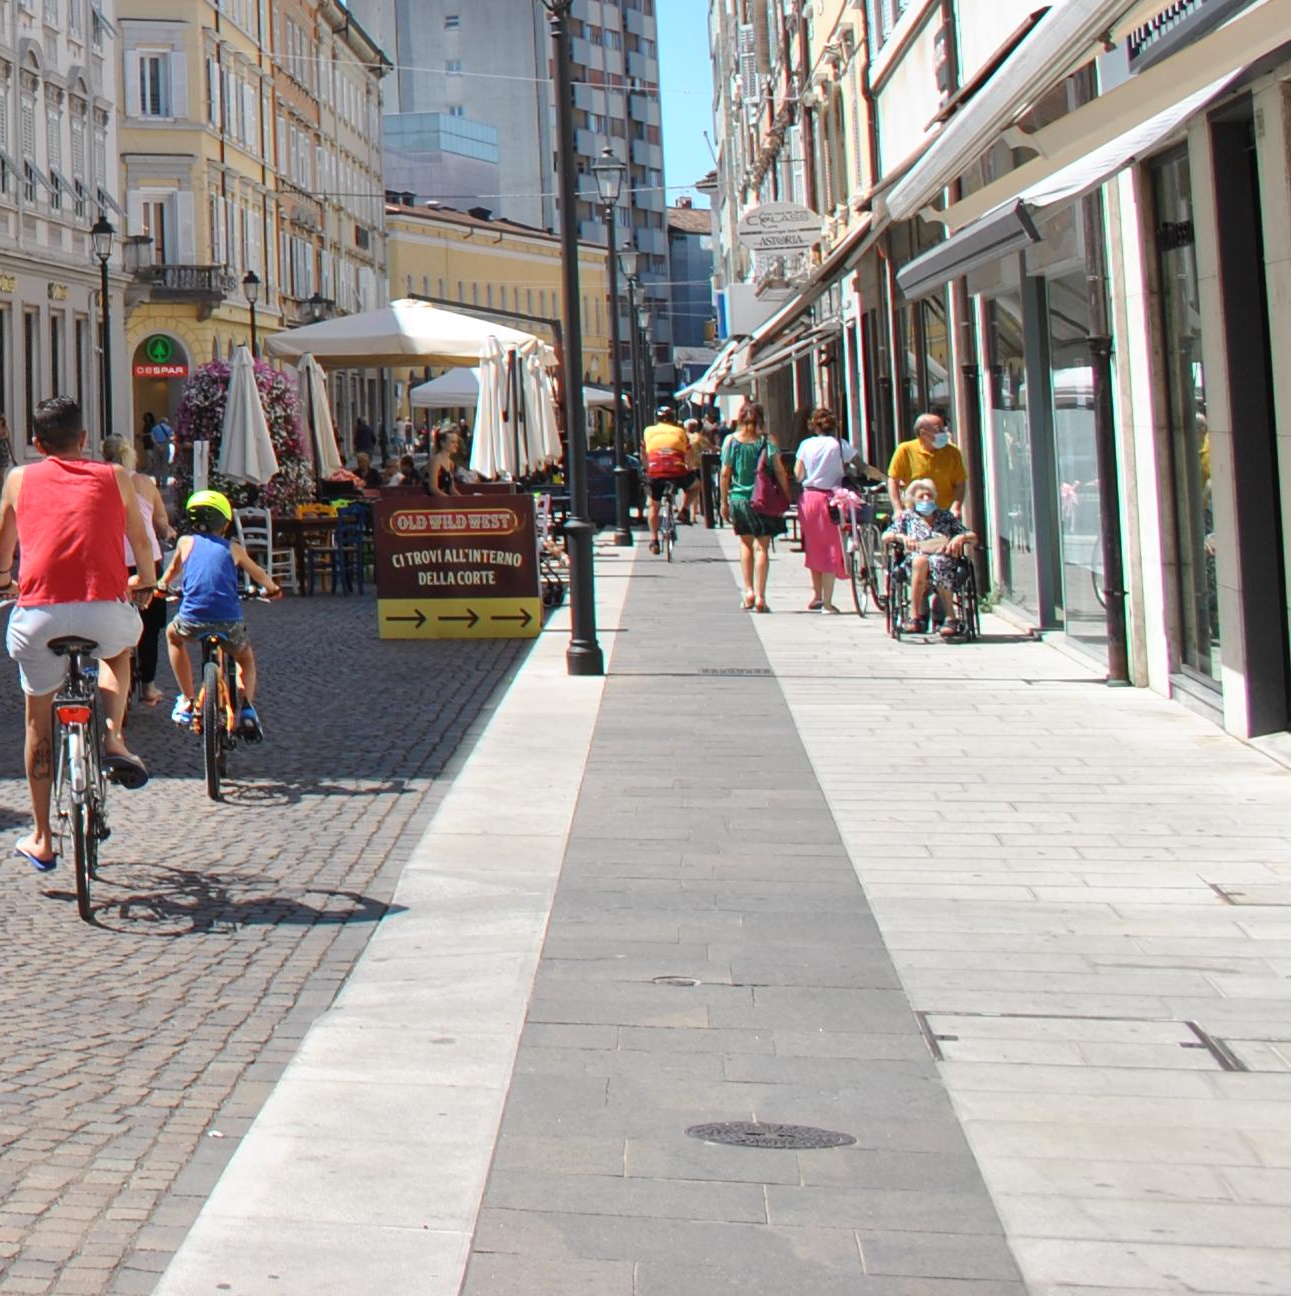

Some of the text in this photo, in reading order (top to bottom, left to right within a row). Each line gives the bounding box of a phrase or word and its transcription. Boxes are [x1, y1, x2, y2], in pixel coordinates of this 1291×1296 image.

[136, 365, 184, 375] DESPAR
[397, 513, 510, 530] OLD WILD WEST
[392, 548, 522, 568] CI TROVI ALL'INTERNO
[419, 570, 496, 585] DELLA CORTE
